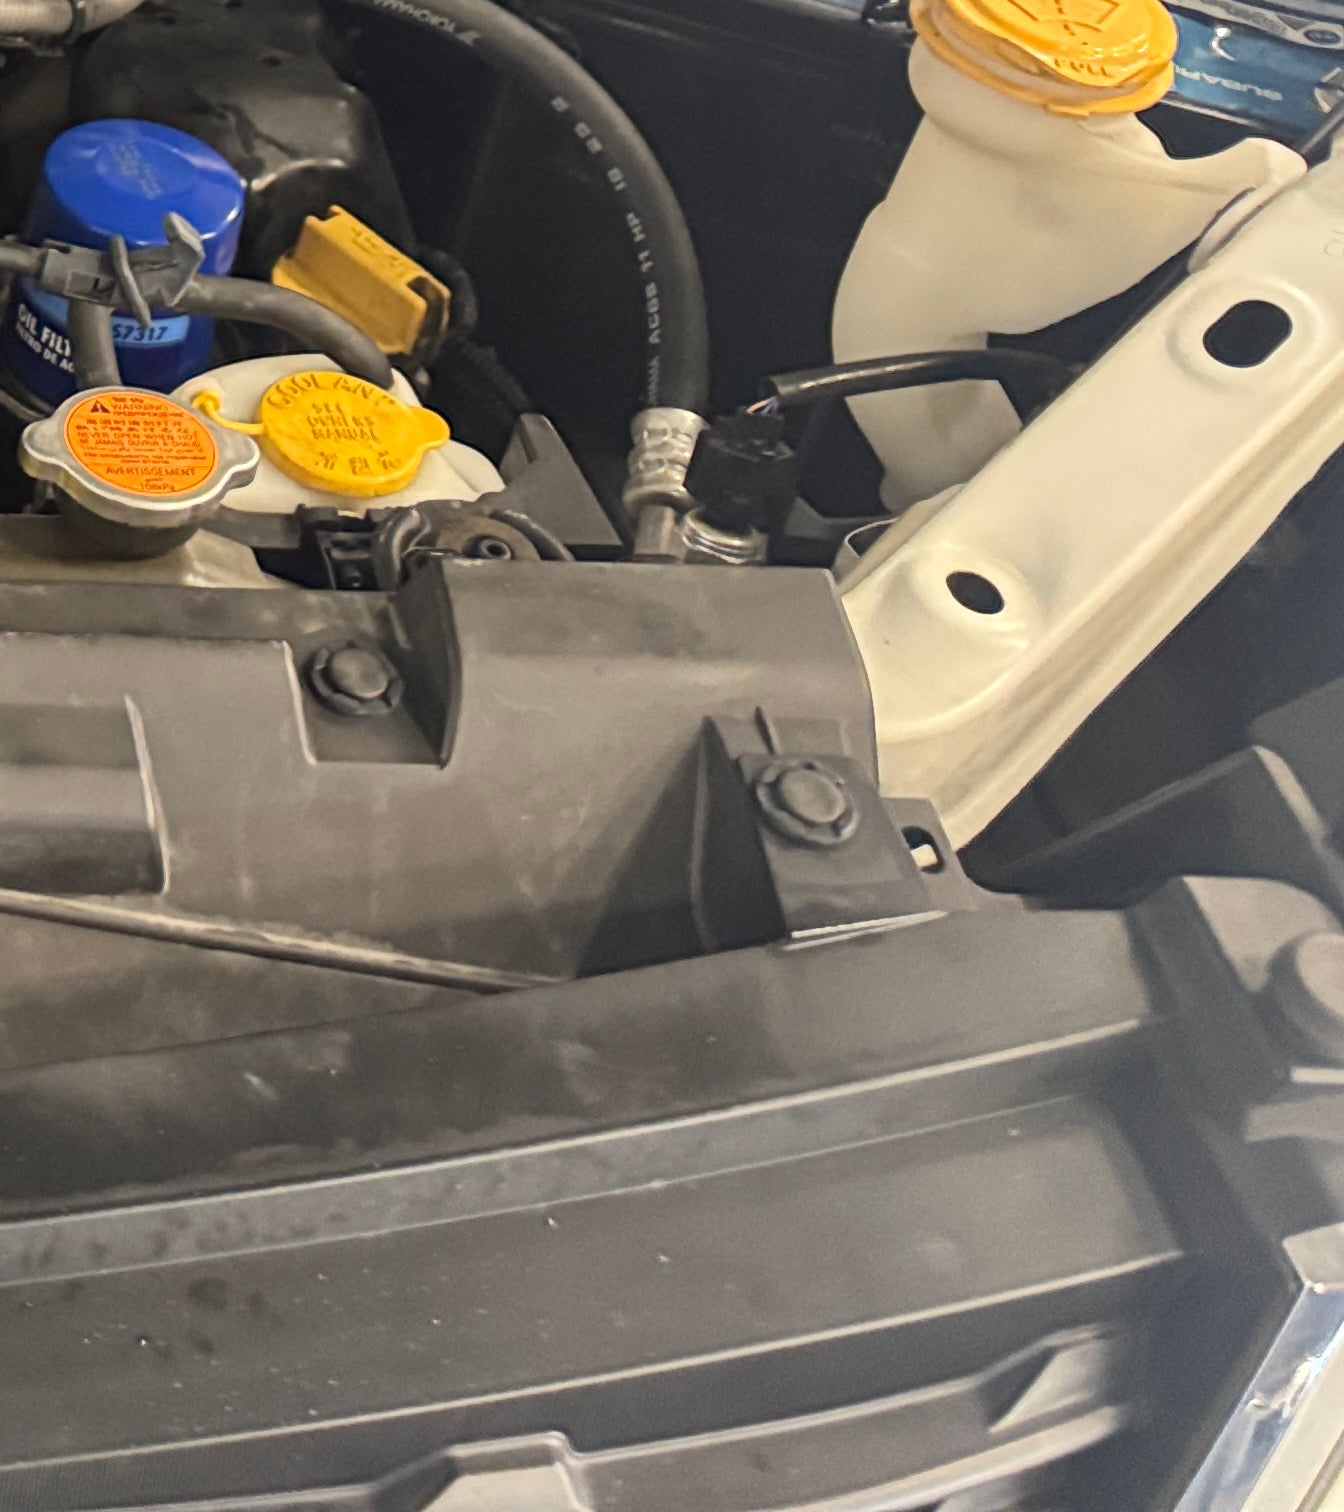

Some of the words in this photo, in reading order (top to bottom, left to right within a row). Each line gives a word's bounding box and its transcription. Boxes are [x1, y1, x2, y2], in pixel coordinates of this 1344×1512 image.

[17, 303, 38, 336] OIL
[40, 325, 72, 357] FILT
[43, 348, 59, 364] DE
[311, 427, 379, 442] MANUAL
[106, 466, 196, 476] AVERTISSEMENT
